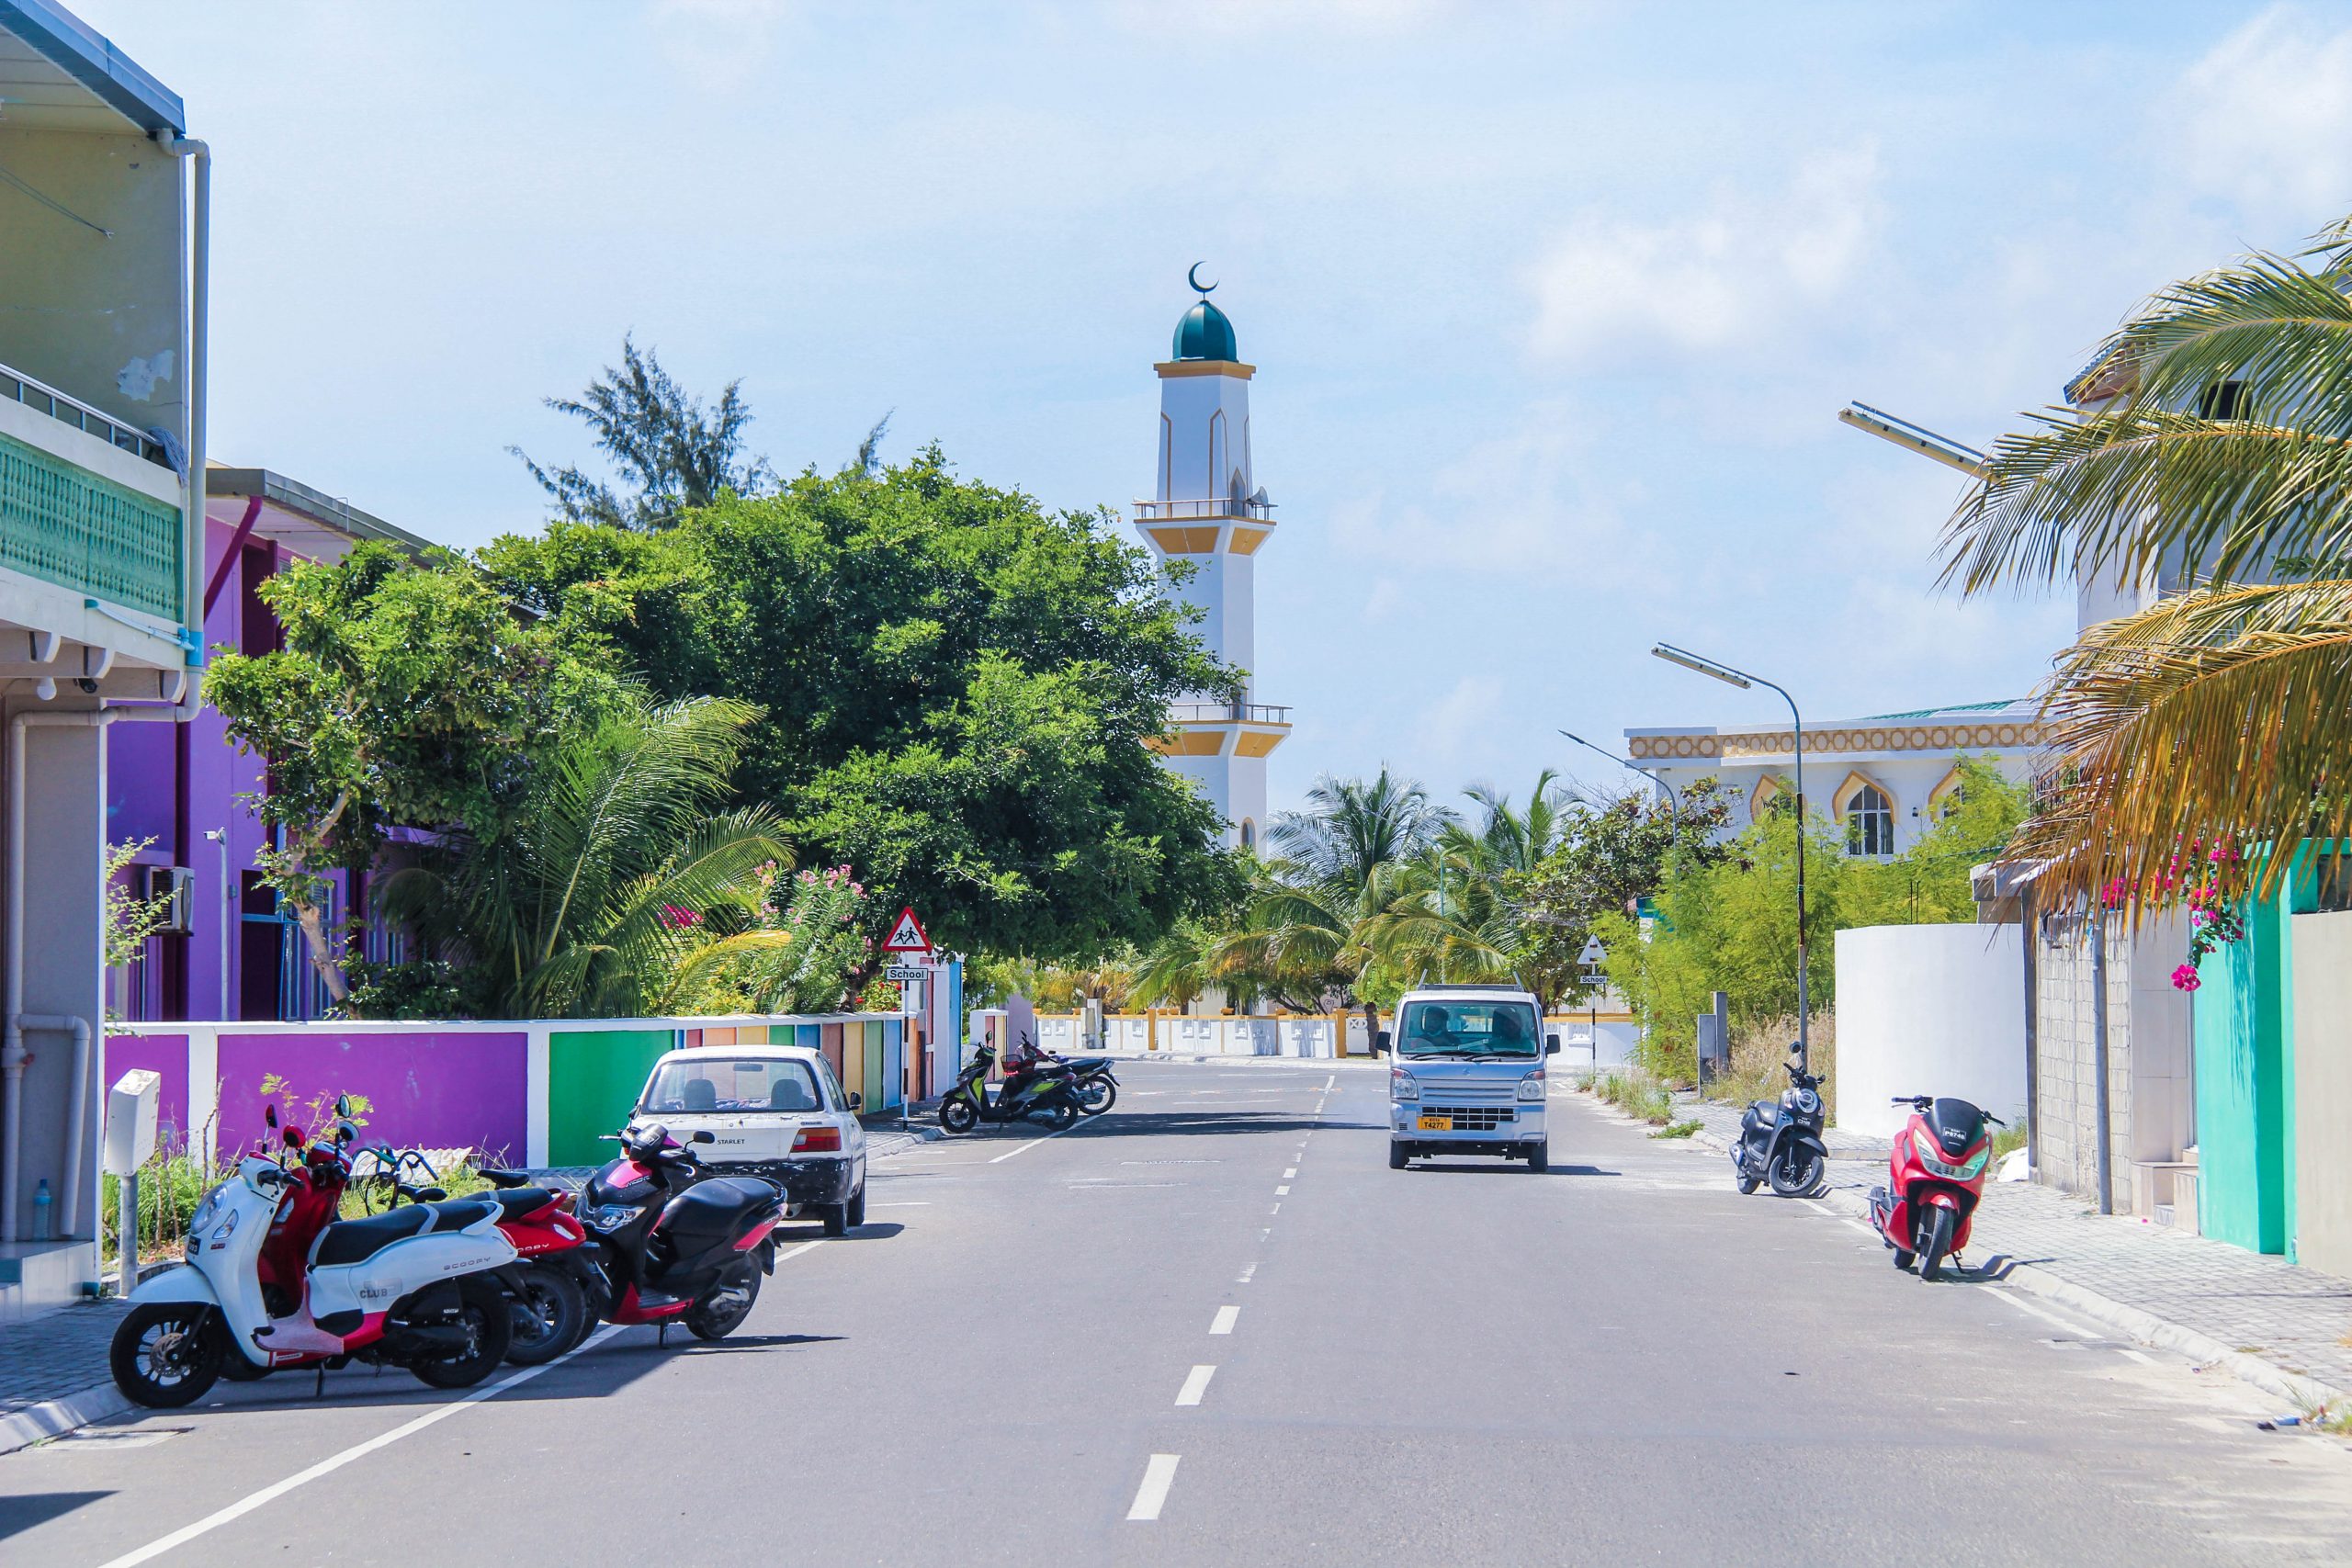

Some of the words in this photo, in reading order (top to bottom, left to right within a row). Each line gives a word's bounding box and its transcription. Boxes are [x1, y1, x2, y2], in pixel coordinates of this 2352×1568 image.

[889, 969, 924, 978] School
[444, 1257, 491, 1270] SCOOPY
[359, 1289, 388, 1299] CLUB
